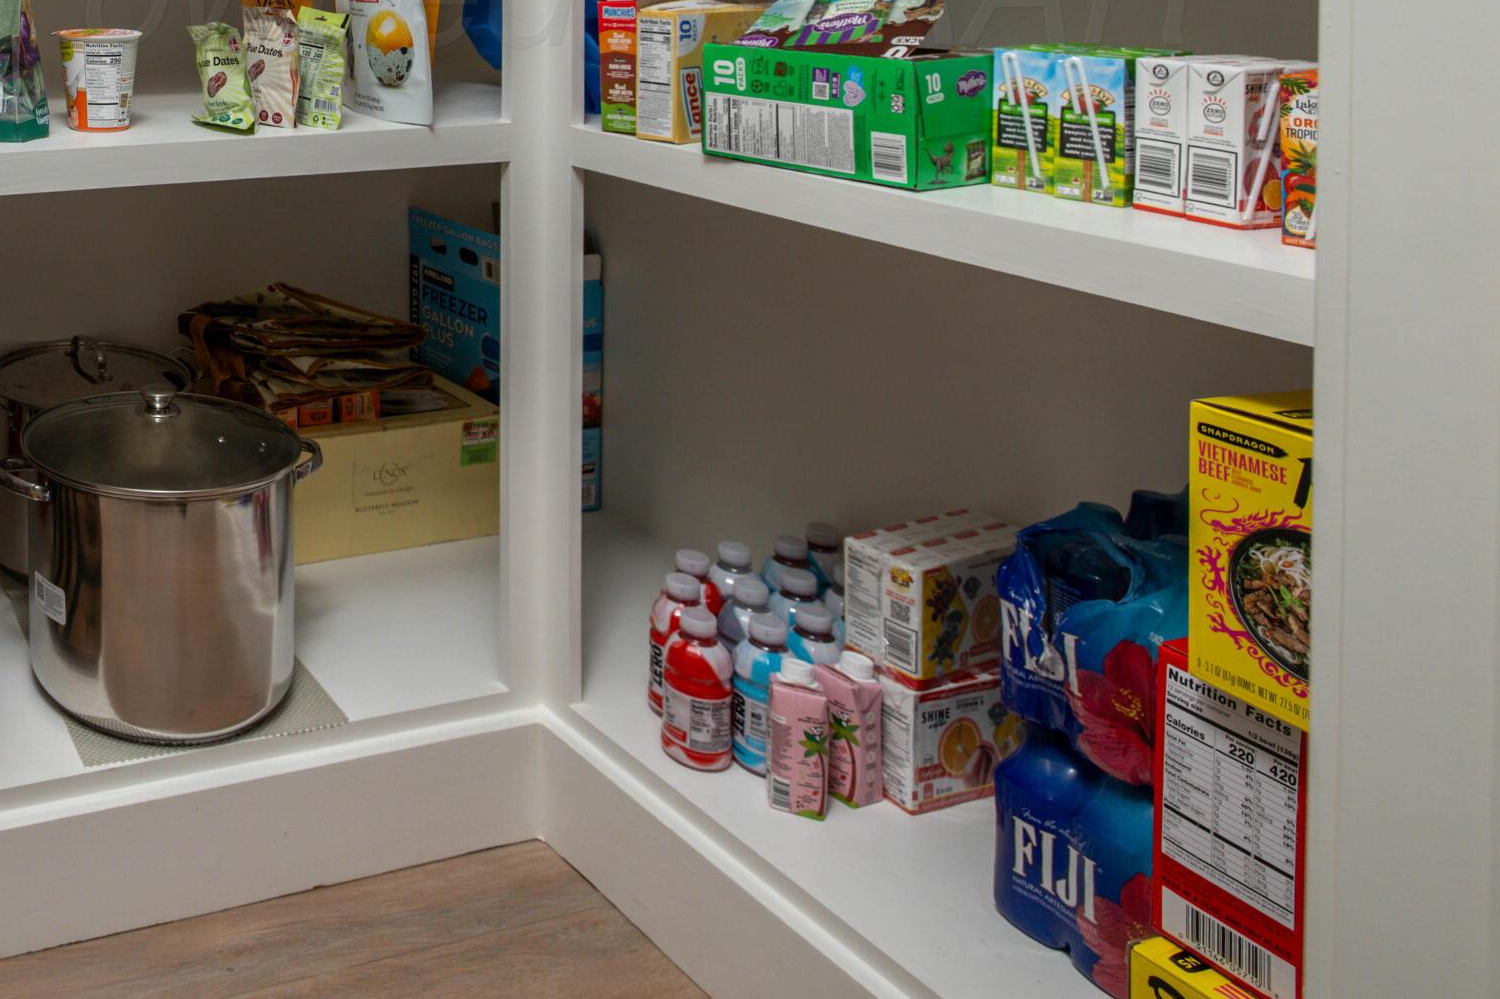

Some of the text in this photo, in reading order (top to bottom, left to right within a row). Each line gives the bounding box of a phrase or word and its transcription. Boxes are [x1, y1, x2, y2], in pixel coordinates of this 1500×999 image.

[679, 20, 692, 42] 10
[213, 56, 240, 67] Dates
[258, 44, 284, 58] Dates
[713, 59, 736, 86] 10
[925, 72, 941, 93] 10
[1206, 107, 1224, 116] ZERO
[422, 286, 488, 327] FREEZER
[422, 304, 474, 337] GALLON
[423, 322, 454, 347] PLUS
[1199, 424, 1275, 455] SNAPDRAGON
[372, 466, 408, 482] LENOX
[1198, 439, 1288, 485] VIETNAMESE
[1198, 456, 1230, 483] BEEF
[1167, 690, 1190, 708] Serving
[1168, 666, 1292, 737] Nutrition Facts
[922, 707, 951, 724] SHINE
[1166, 713, 1206, 742] Calories
[1228, 743, 1255, 766] 220
[1268, 764, 1297, 787] 420
[1011, 815, 1098, 926] FIJI
